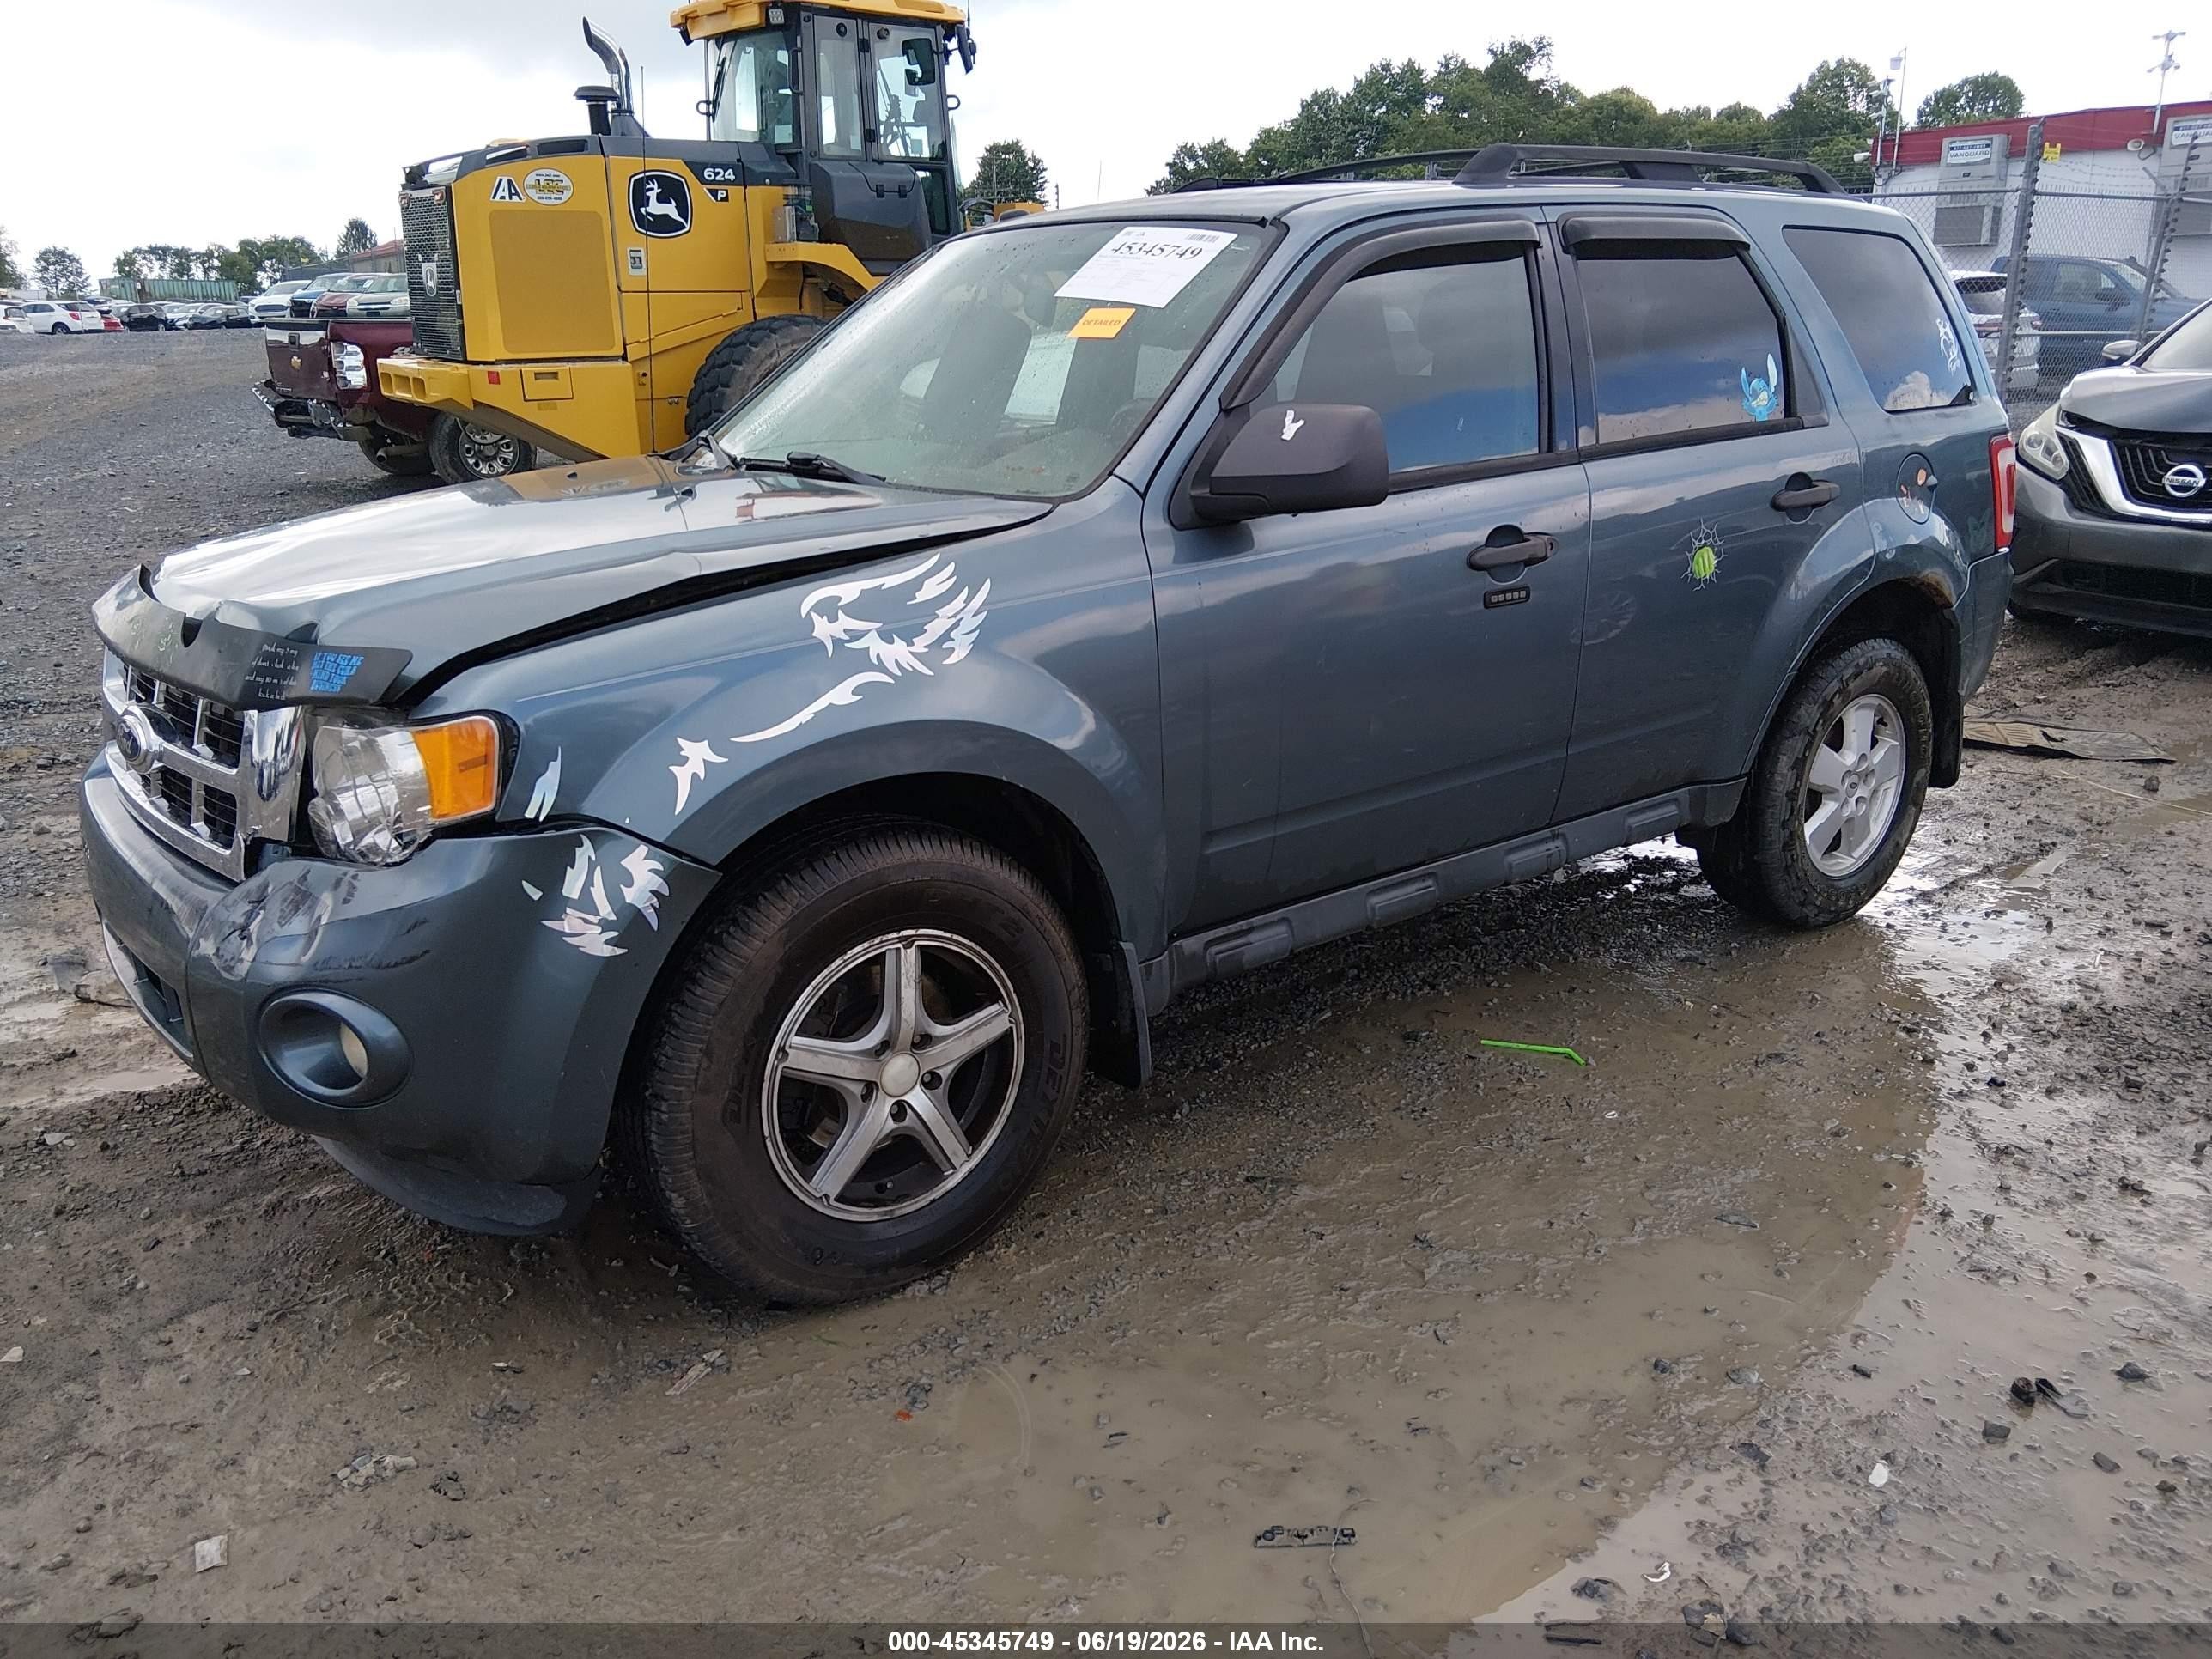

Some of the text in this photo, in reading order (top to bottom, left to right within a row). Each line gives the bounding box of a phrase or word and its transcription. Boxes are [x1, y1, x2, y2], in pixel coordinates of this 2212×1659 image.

[703, 168, 736, 181] 624
[717, 190, 727, 201] P
[1112, 241, 1203, 260] 45345749
[2166, 477, 2199, 487] NISSAN
[336, 653, 351, 665] SEE
[349, 655, 364, 666] ME
